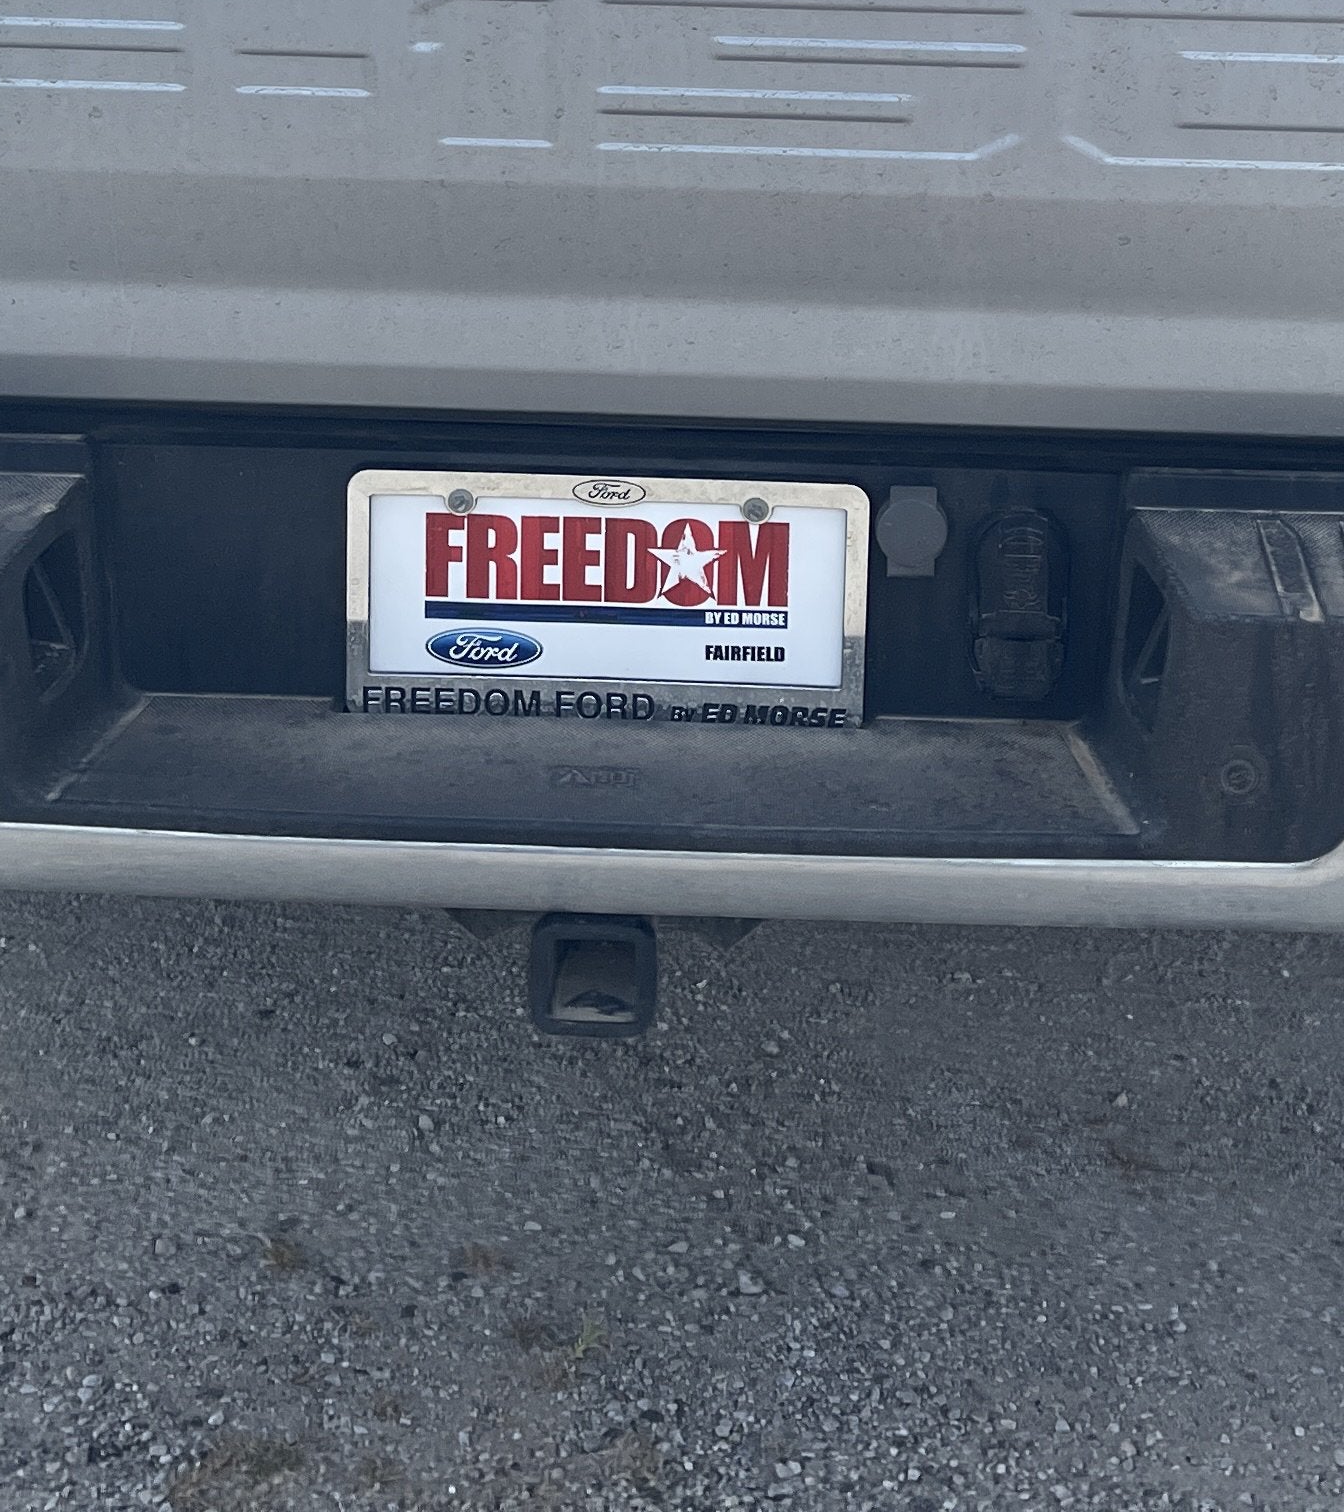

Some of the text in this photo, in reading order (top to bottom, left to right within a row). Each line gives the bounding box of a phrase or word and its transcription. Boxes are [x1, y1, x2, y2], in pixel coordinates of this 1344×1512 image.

[587, 483, 632, 503] Ford
[424, 512, 790, 608] FREEDOM
[704, 611, 786, 627] BY ED MORSE
[449, 632, 520, 663] Ford
[705, 644, 786, 663] FAIRFIELD
[362, 685, 542, 718] FREEDOM
[555, 691, 656, 721] FORD
[702, 703, 738, 725] ED
[743, 704, 847, 729] MORSE
